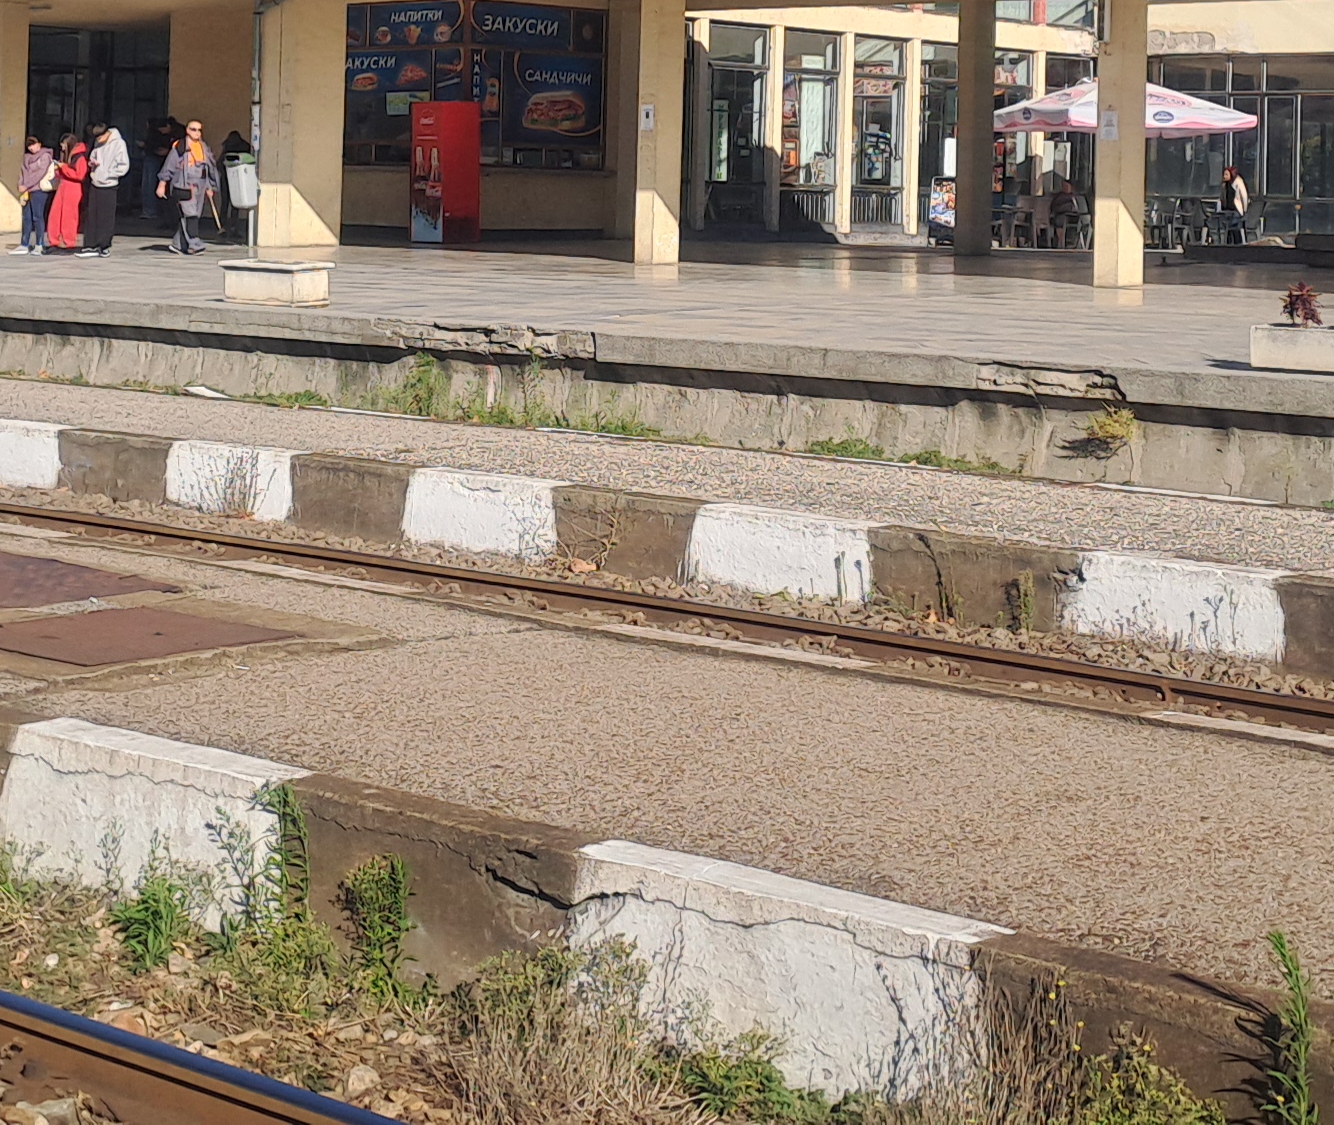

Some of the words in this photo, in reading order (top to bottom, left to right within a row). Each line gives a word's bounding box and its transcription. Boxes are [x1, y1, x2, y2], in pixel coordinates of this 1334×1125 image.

[390, 9, 443, 24] НАПИТКИ
[481, 14, 559, 37] ЗАКУСКИ
[345, 55, 396, 70] АКУСКИ
